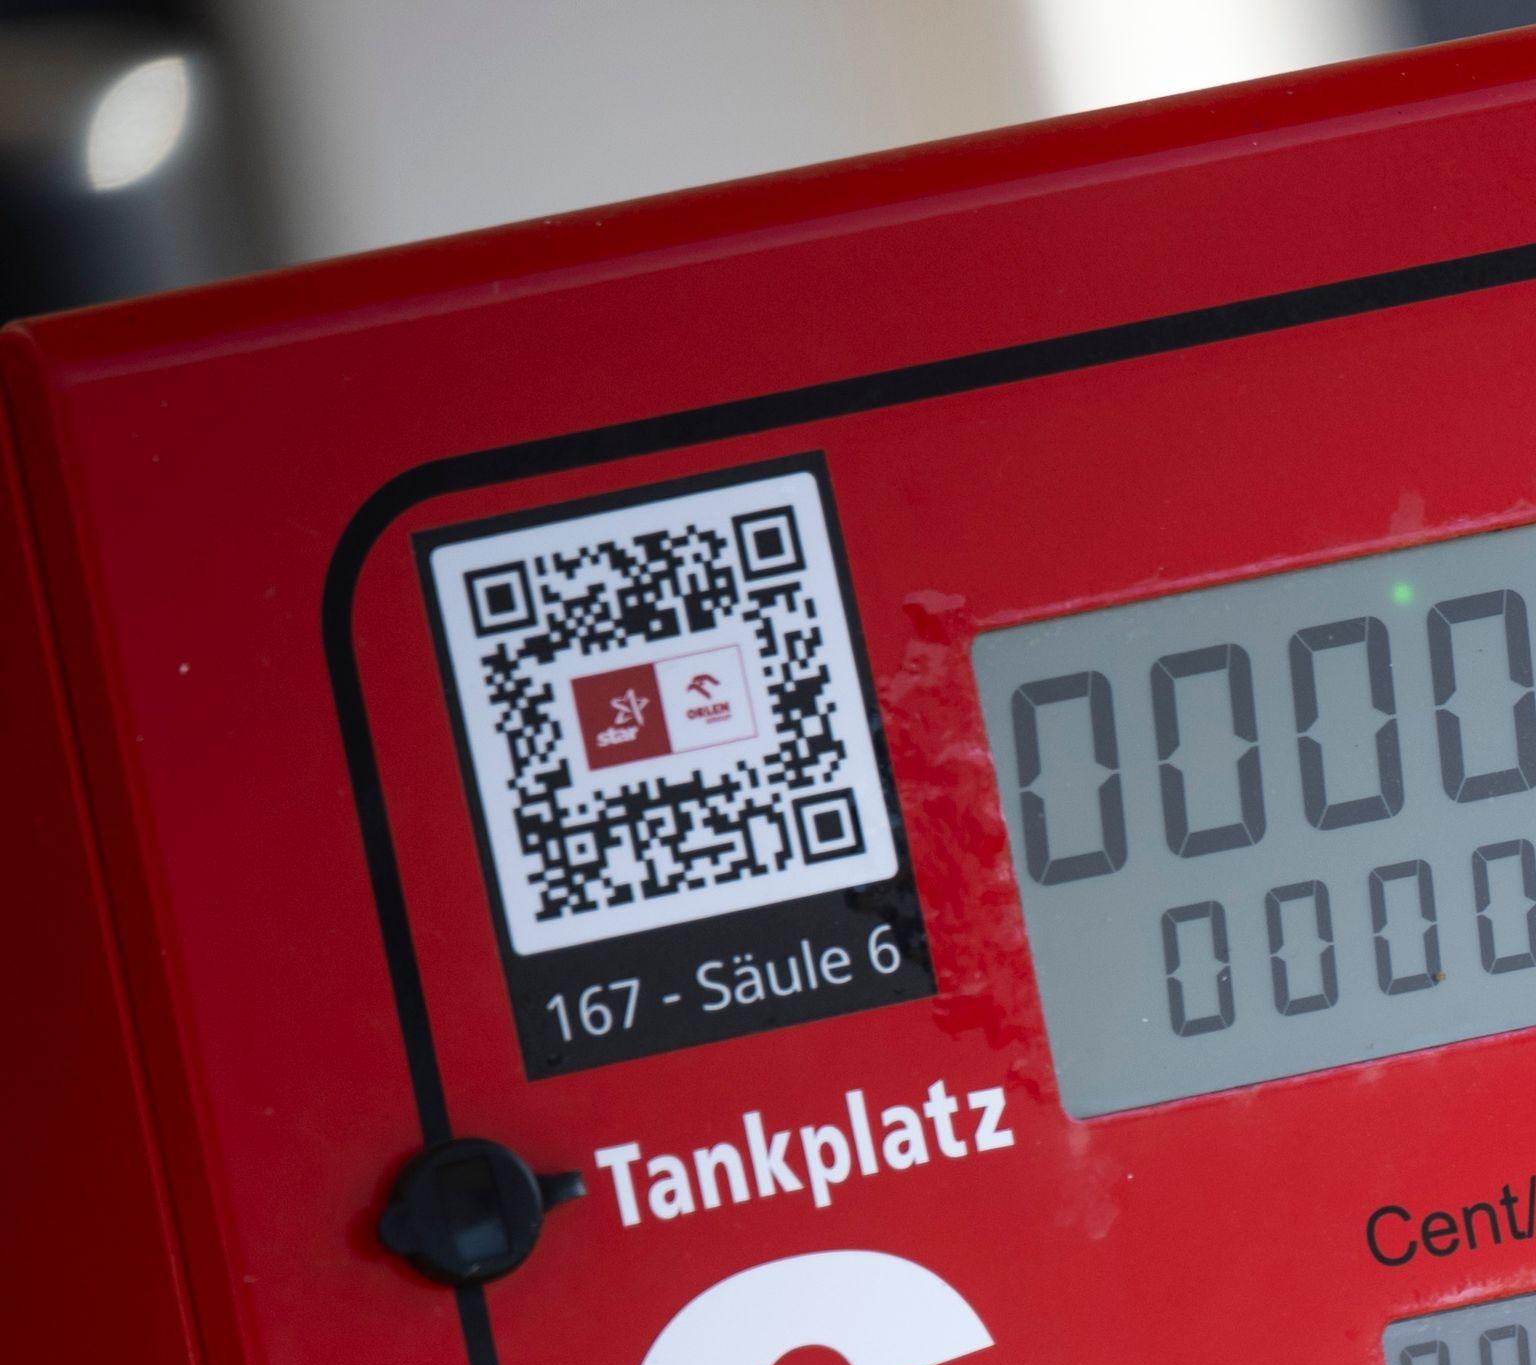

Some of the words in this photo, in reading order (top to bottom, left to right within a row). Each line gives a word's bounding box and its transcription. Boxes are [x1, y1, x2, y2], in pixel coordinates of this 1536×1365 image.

[596, 724, 640, 748] star
[686, 702, 730, 720] ORLEN
[546, 977, 642, 1042] 167
[697, 939, 853, 1012] Säule
[868, 923, 902, 976] 6
[594, 1079, 1015, 1227] Tankplatz
